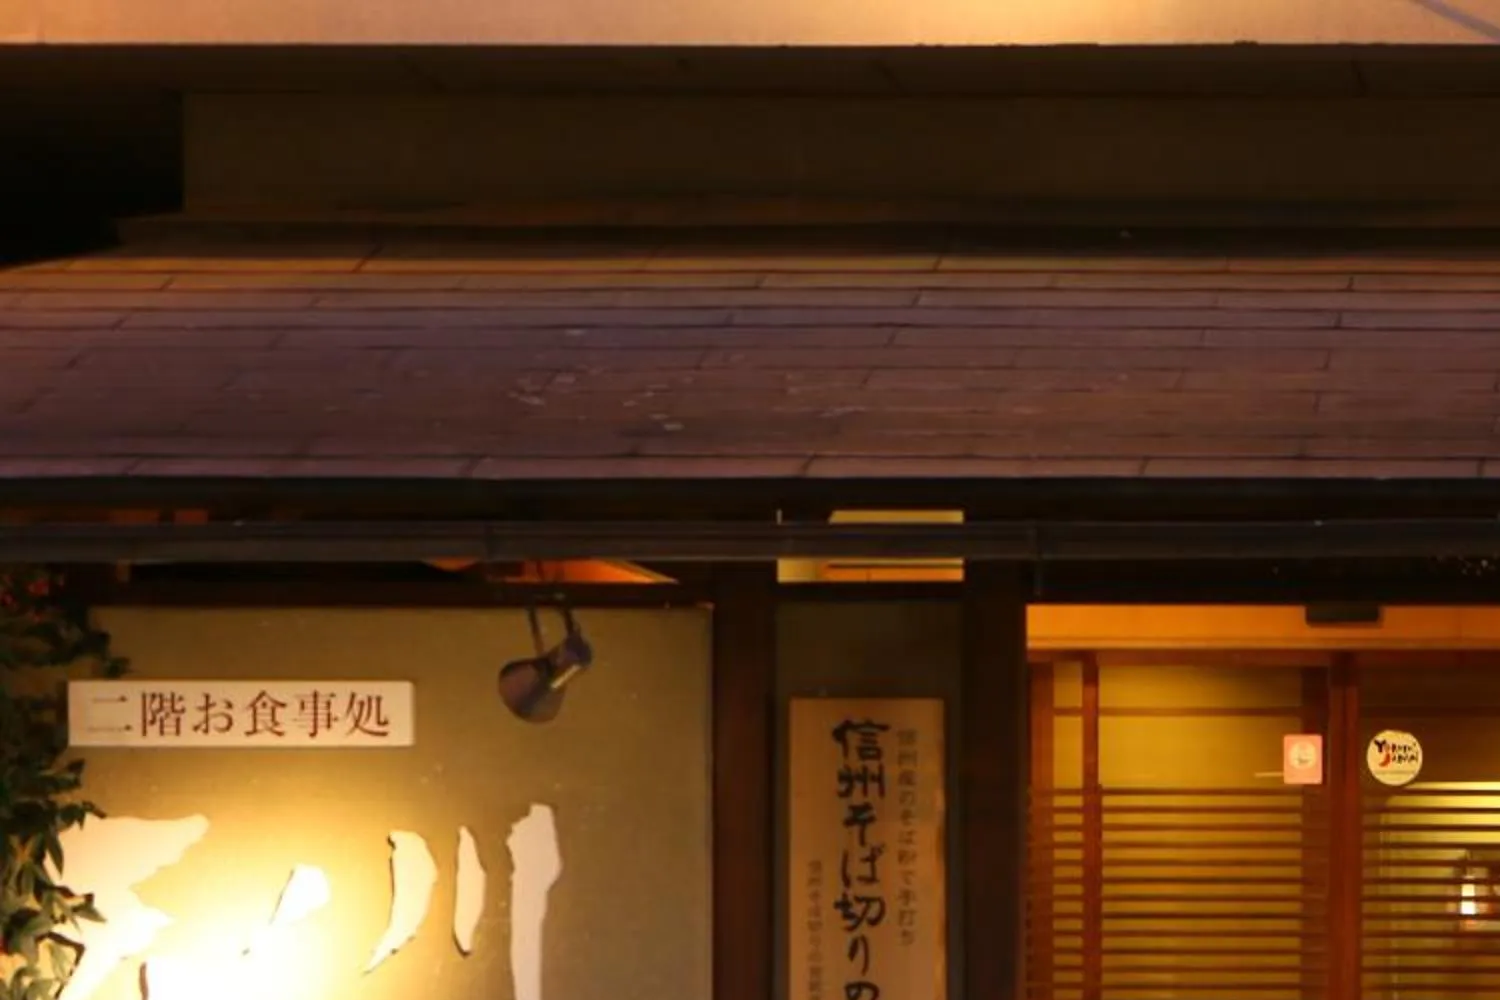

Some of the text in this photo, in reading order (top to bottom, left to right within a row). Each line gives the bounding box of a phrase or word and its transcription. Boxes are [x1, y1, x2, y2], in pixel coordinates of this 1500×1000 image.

[88, 690, 391, 739] 二階お食事処
